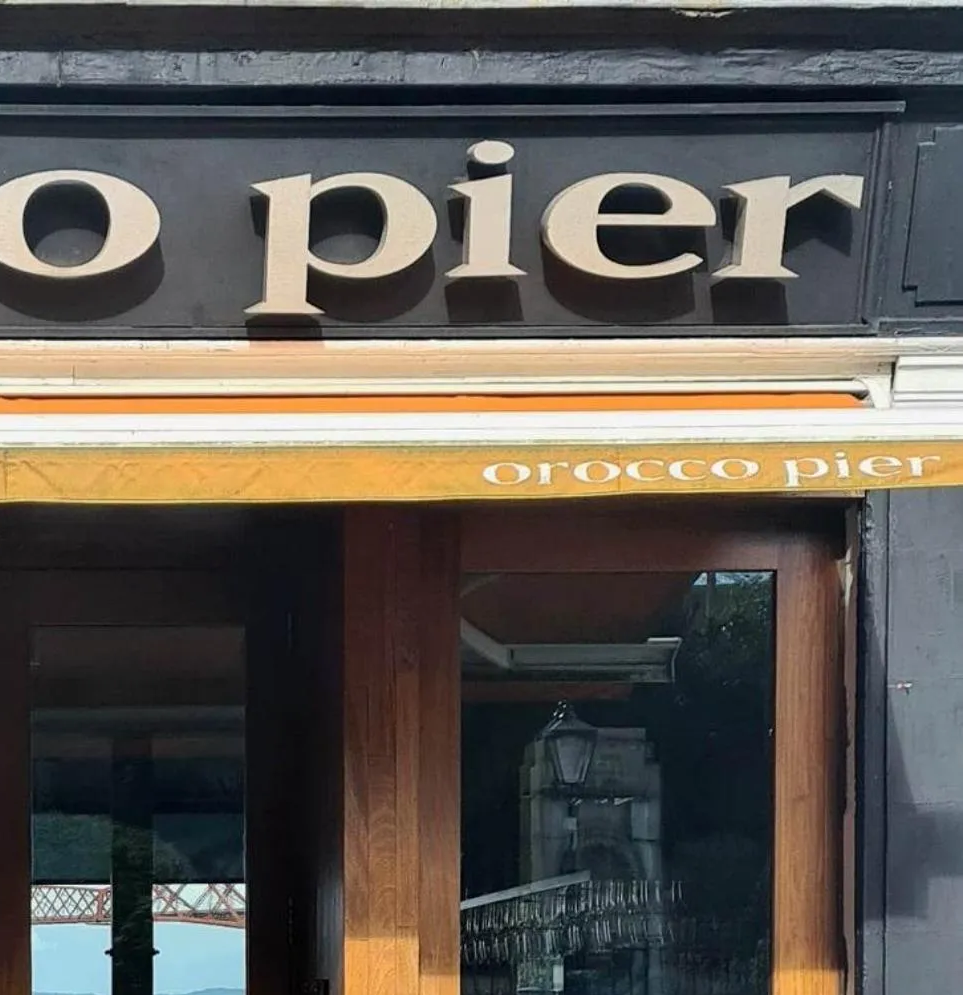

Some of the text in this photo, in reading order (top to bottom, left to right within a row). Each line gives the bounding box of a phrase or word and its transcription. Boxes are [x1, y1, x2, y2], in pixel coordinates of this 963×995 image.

[245, 140, 864, 315] pier
[482, 451, 941, 487] orocco pier
